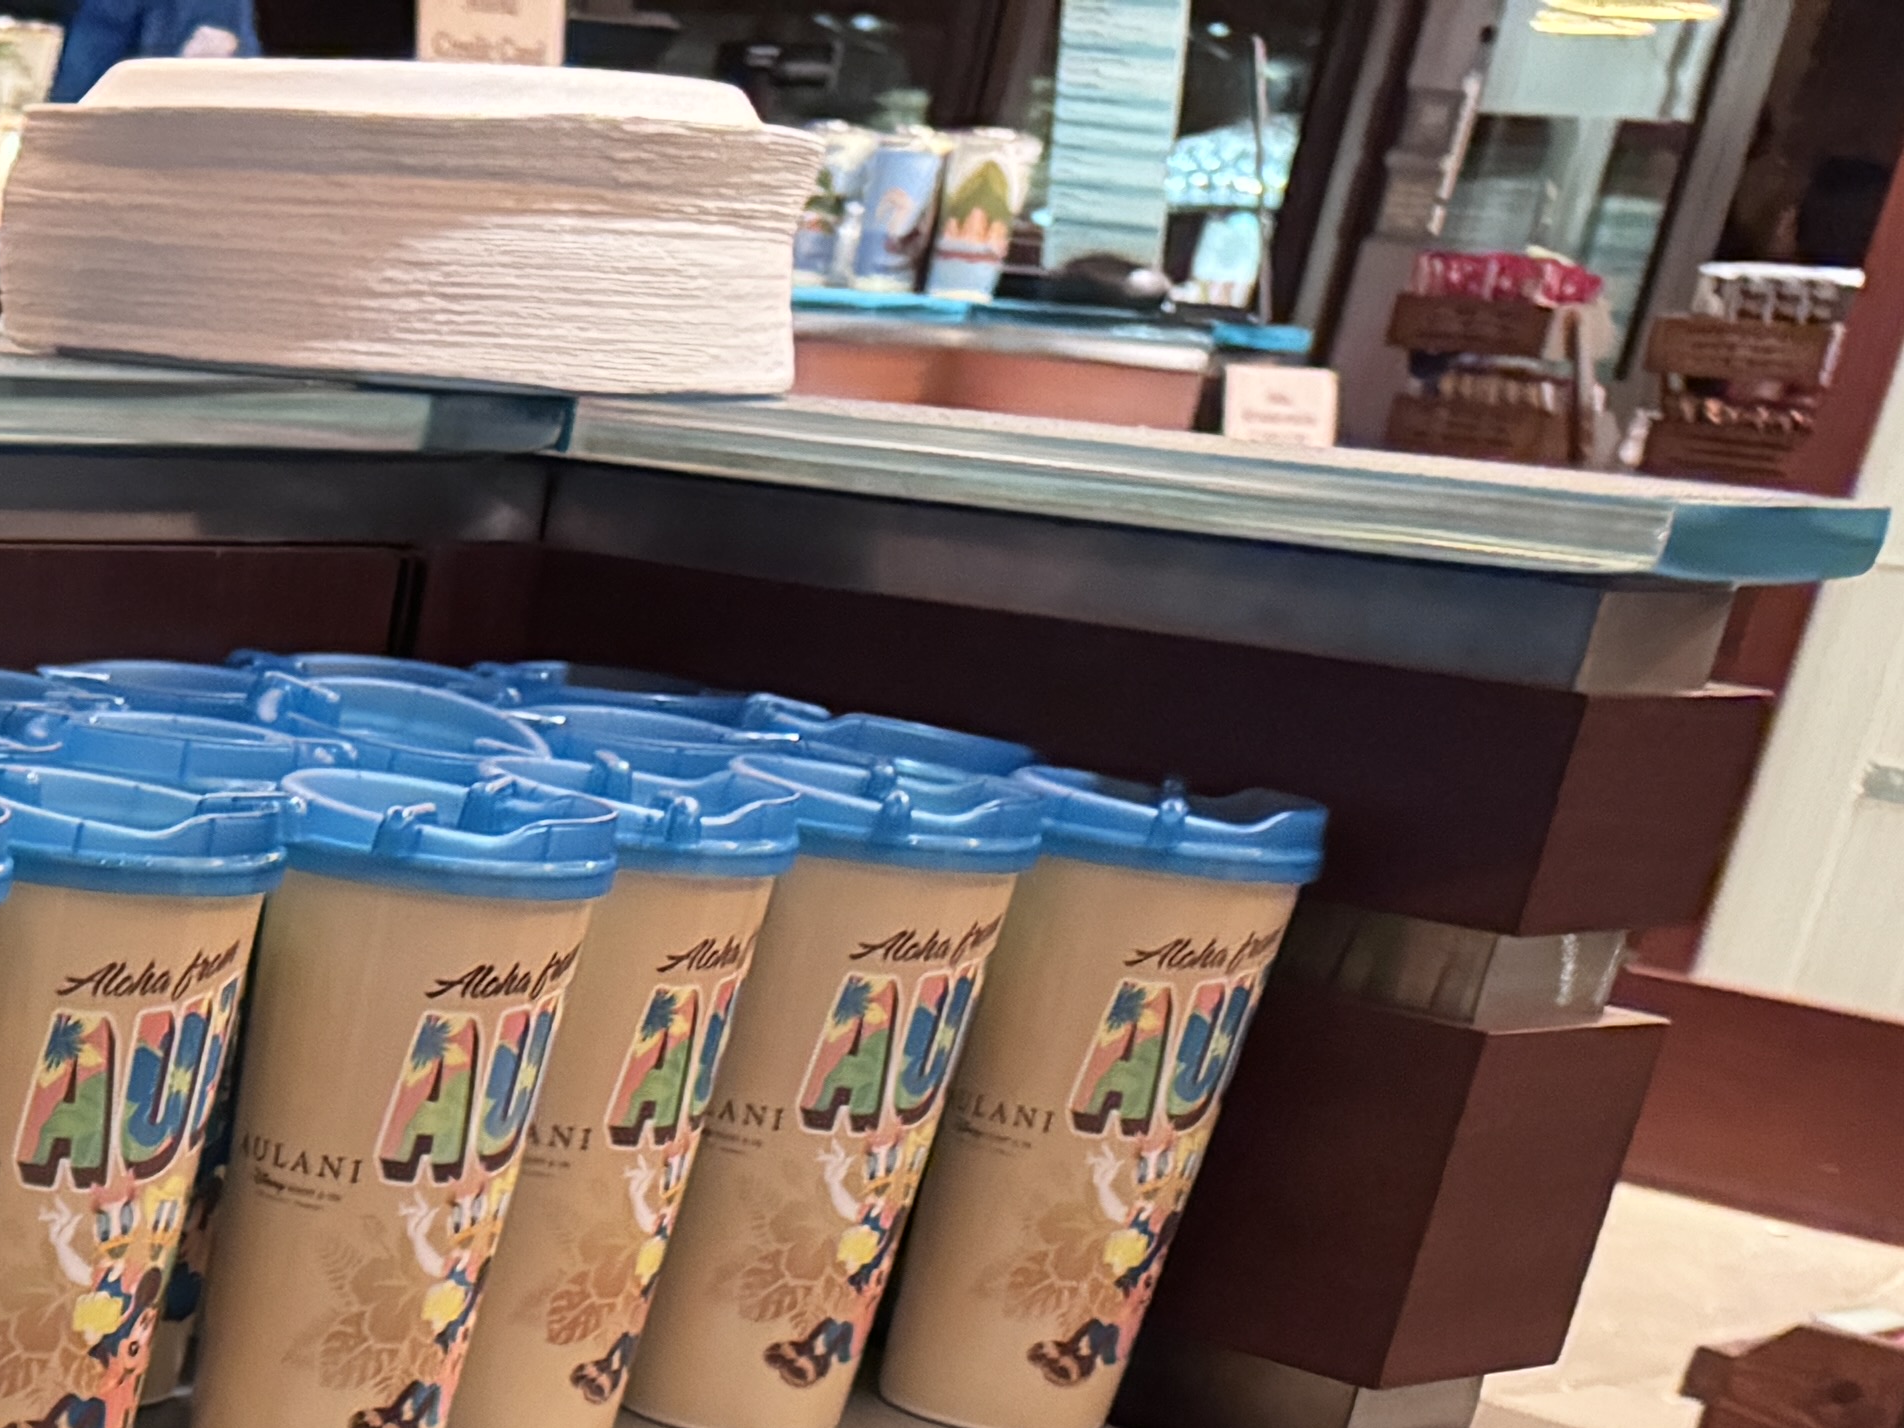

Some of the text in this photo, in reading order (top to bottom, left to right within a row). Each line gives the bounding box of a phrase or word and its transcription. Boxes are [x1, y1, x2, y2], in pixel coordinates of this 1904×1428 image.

[849, 929, 952, 964] Aloha
[1125, 938, 1226, 972] Aloha
[57, 958, 169, 998] Aloha
[426, 962, 530, 999] Aloha
